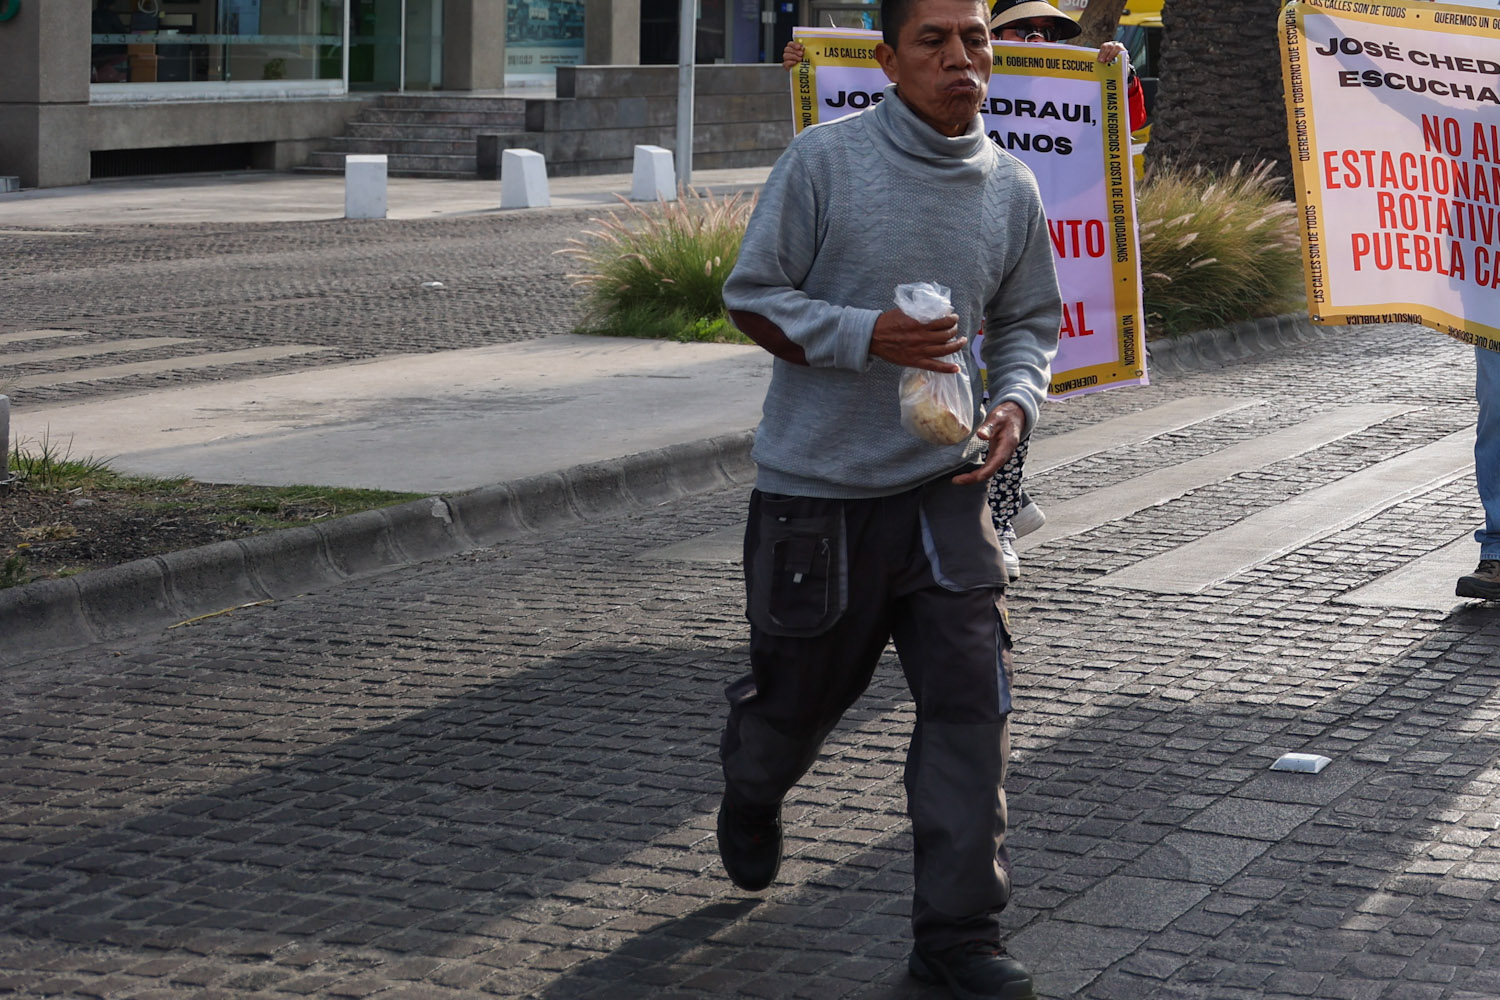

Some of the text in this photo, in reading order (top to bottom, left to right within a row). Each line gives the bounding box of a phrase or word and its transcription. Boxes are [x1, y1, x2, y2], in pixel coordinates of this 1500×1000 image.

[1324, 0, 1352, 12] CALLES
[1353, 3, 1369, 15] SON
[1370, 5, 1379, 16] DE
[1382, 5, 1406, 19] TODOS
[1434, 12, 1477, 27] QUEREMOS
[1478, 17, 1489, 29] UN
[824, 47, 839, 58] LAS
[840, 48, 867, 59] CALLES
[1315, 37, 1404, 62] JOSÉ
[993, 55, 1094, 73] UN GOBIERNO QUE ESCUCHE
[799, 58, 810, 94] ESCUCHE
[1106, 79, 1117, 91] NO
[1285, 8, 1310, 162] QUEREMOS UN GOBIERNO QUE ESCUCHE
[800, 95, 812, 111] QUE
[825, 90, 1097, 127] JOS EDRAUI,
[1106, 92, 1118, 111] MAS
[1107, 112, 1120, 151] NEGOCIOS
[1421, 113, 1462, 157] NO
[1110, 162, 1122, 187] COSTA
[1112, 189, 1123, 198] DE
[1113, 202, 1123, 215] LOS
[1113, 215, 1128, 263] CIUDADANOS
[1305, 205, 1324, 304] LAS CALLES SON DE TODOS
[1351, 232, 1466, 281] PUEBLA
[1382, 313, 1422, 325] CONSULTA
[1122, 315, 1135, 366] NO IMPOSICION
[1474, 334, 1488, 349] QUE
[1055, 374, 1098, 394] QUEREMOS
